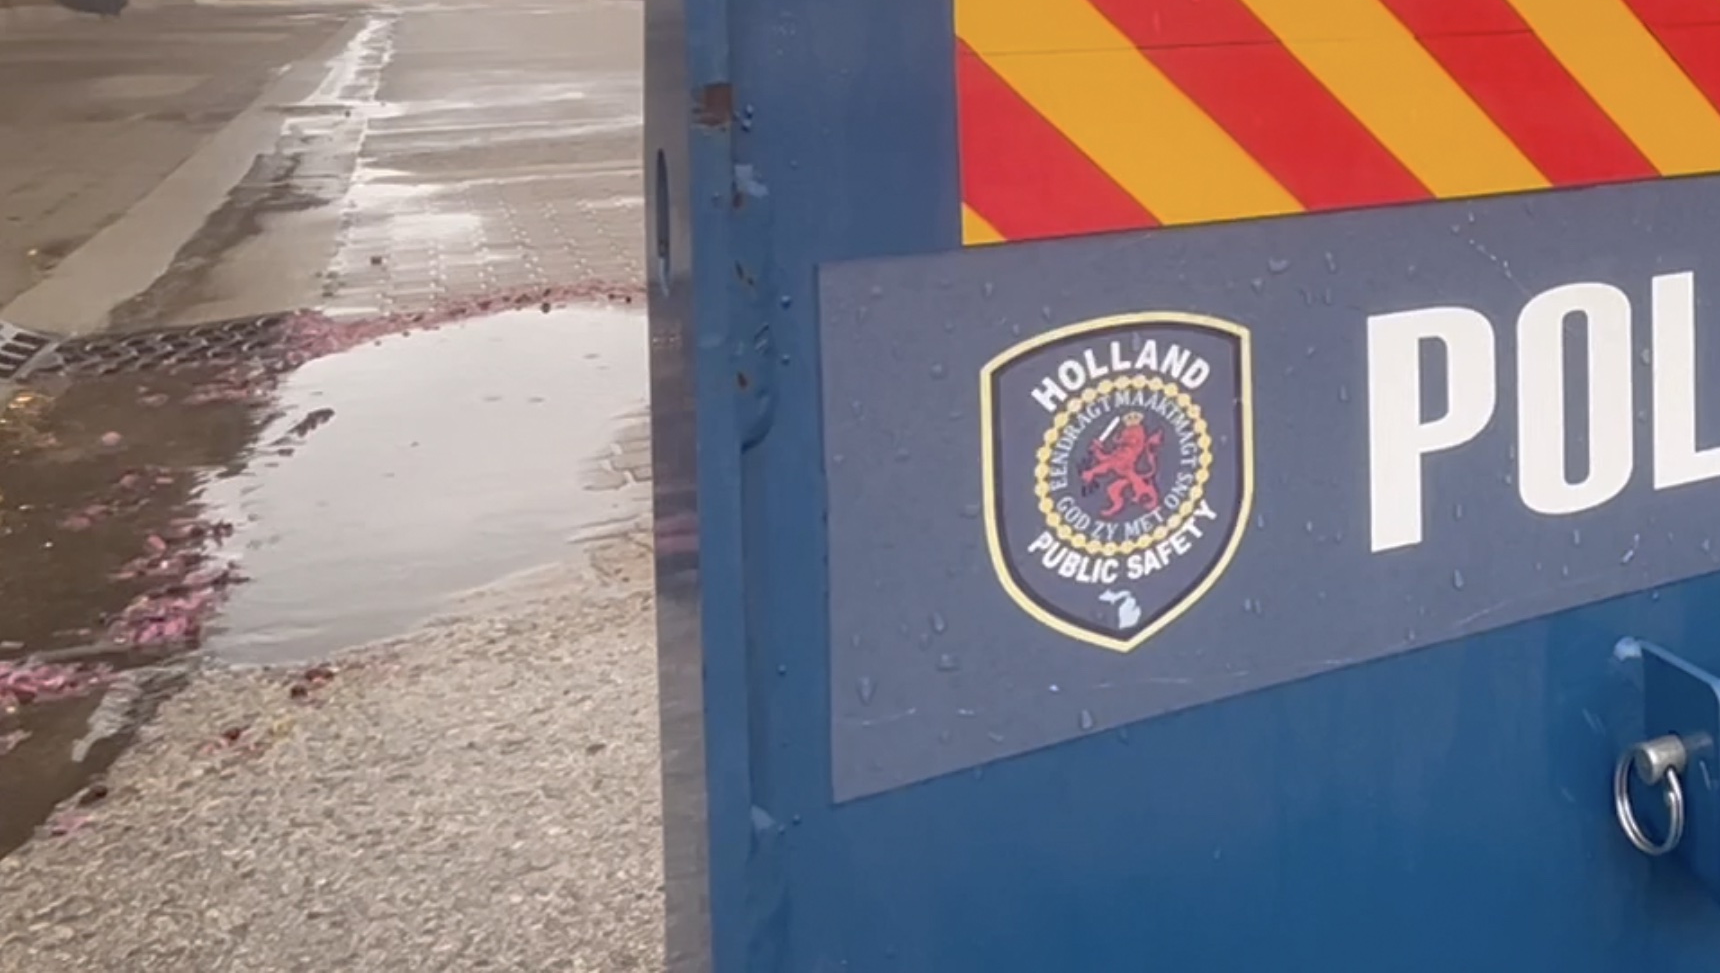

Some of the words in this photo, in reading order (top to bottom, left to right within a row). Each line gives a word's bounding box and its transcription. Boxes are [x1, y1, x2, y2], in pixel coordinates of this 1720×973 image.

[1030, 339, 1210, 411] HOLLAND
[1027, 530, 1119, 584] PUBLIC
[1127, 498, 1218, 580] SAFETY
[1056, 495, 1091, 531] GOD
[1124, 506, 1164, 538] MET
